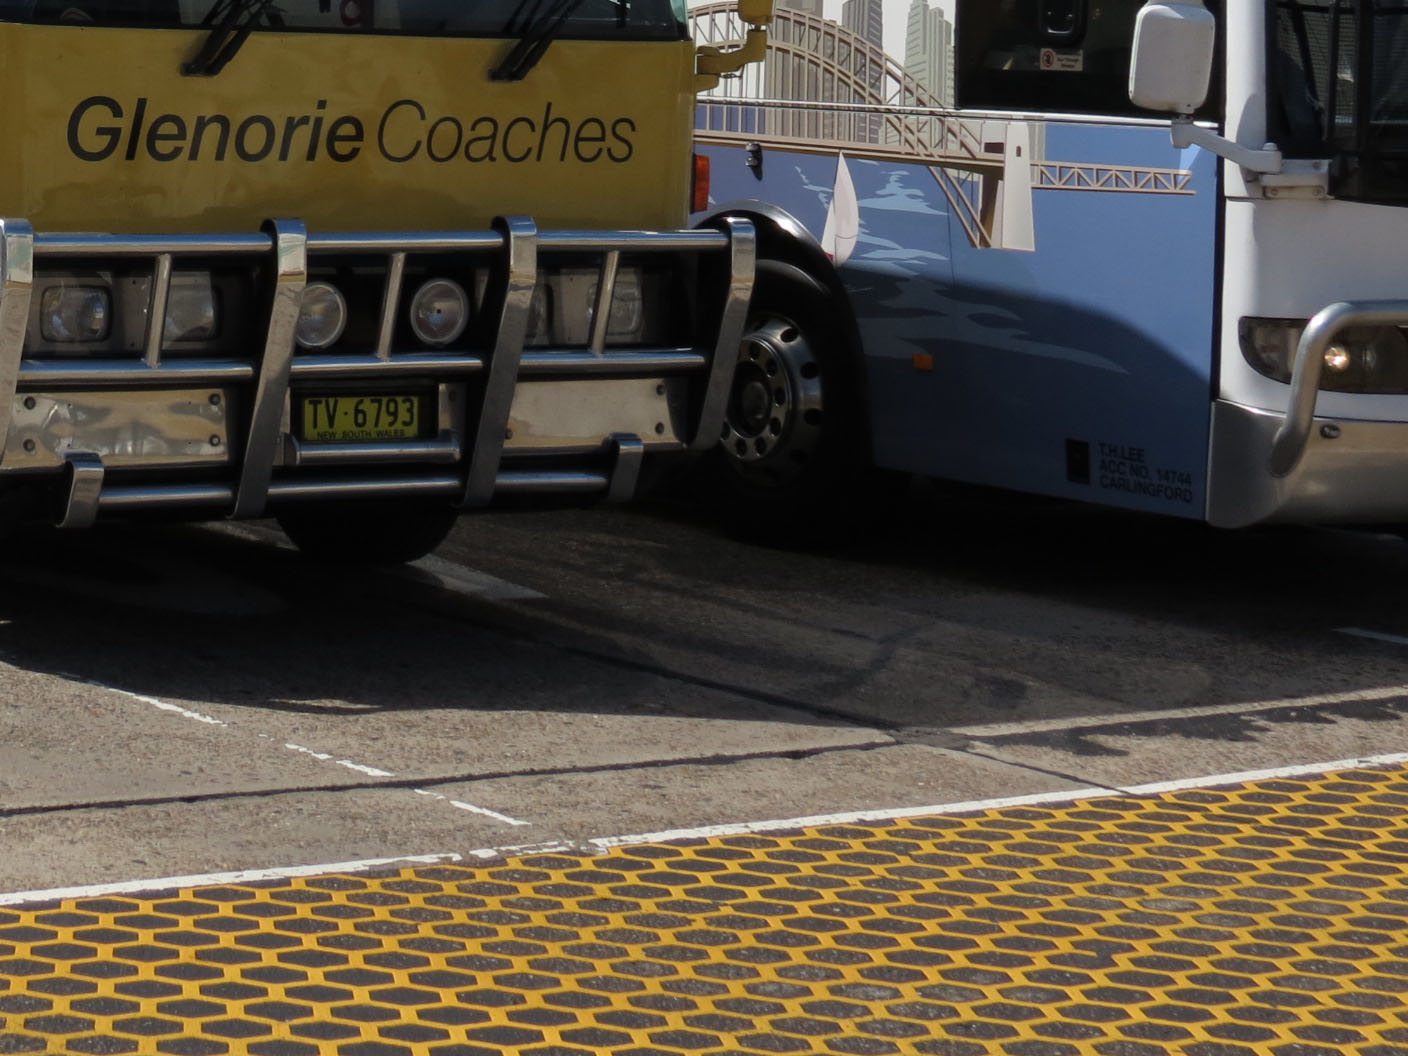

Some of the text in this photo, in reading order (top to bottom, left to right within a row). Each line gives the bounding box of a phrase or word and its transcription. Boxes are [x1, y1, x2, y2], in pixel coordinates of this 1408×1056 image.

[67, 96, 637, 163] Glenorie Coaches
[317, 429, 405, 440] NEW SOUTH WALES
[1099, 459, 1127, 475] ACC
[1099, 474, 1193, 503] CARLINGFORD
